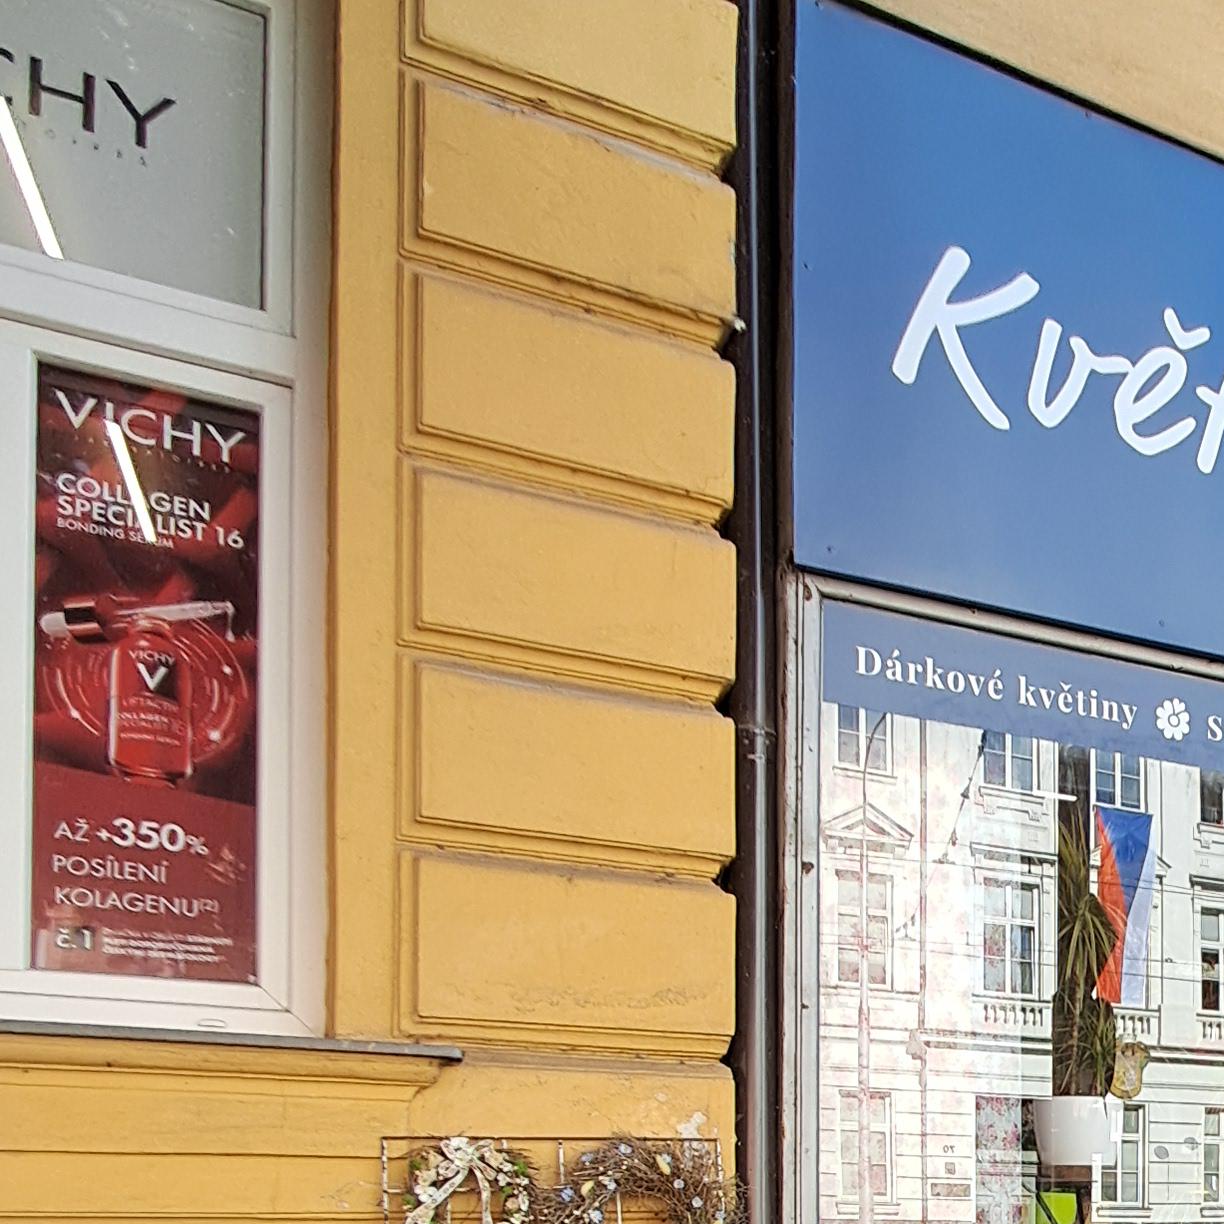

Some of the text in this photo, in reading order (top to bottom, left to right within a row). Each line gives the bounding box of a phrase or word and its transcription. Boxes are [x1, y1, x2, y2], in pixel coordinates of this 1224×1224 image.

[0, 47, 177, 149] HY
[57, 472, 211, 522] COLLGEN
[57, 495, 245, 549] SPECILIST 16
[57, 517, 126, 539] BONDING
[856, 645, 1004, 700] Dárkové
[1018, 675, 1137, 729] květiny
[54, 817, 209, 856] AŽ +350%
[52, 854, 169, 885] POSÍLENÍ
